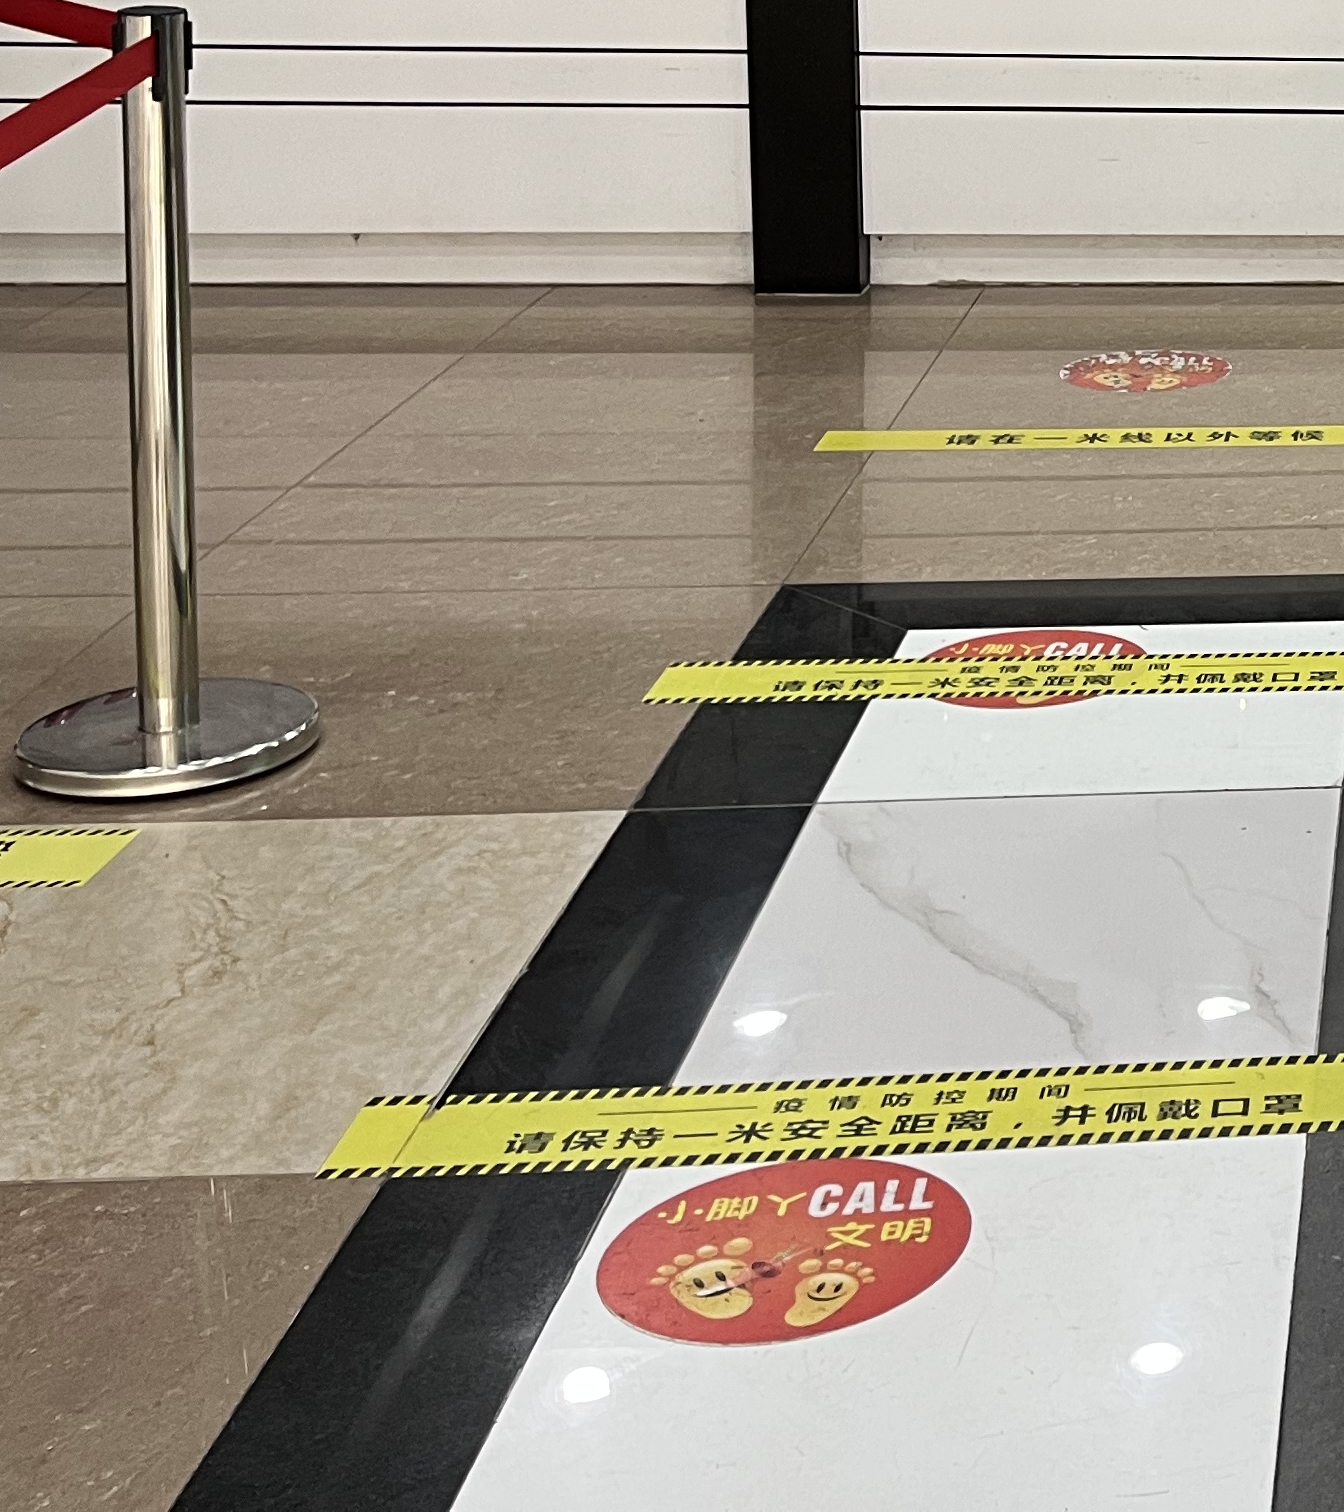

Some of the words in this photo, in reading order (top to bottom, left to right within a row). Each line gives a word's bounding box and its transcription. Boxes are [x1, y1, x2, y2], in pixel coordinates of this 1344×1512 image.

[945, 428, 1326, 446] 请在一米线以外等候
[960, 662, 1171, 675] 疫情防控期间
[773, 1084, 1071, 1114] 疫情防控期间
[504, 1094, 1303, 1155] 请保持一米安全距离，并佩戴口罩
[826, 1217, 932, 1251] 文明
